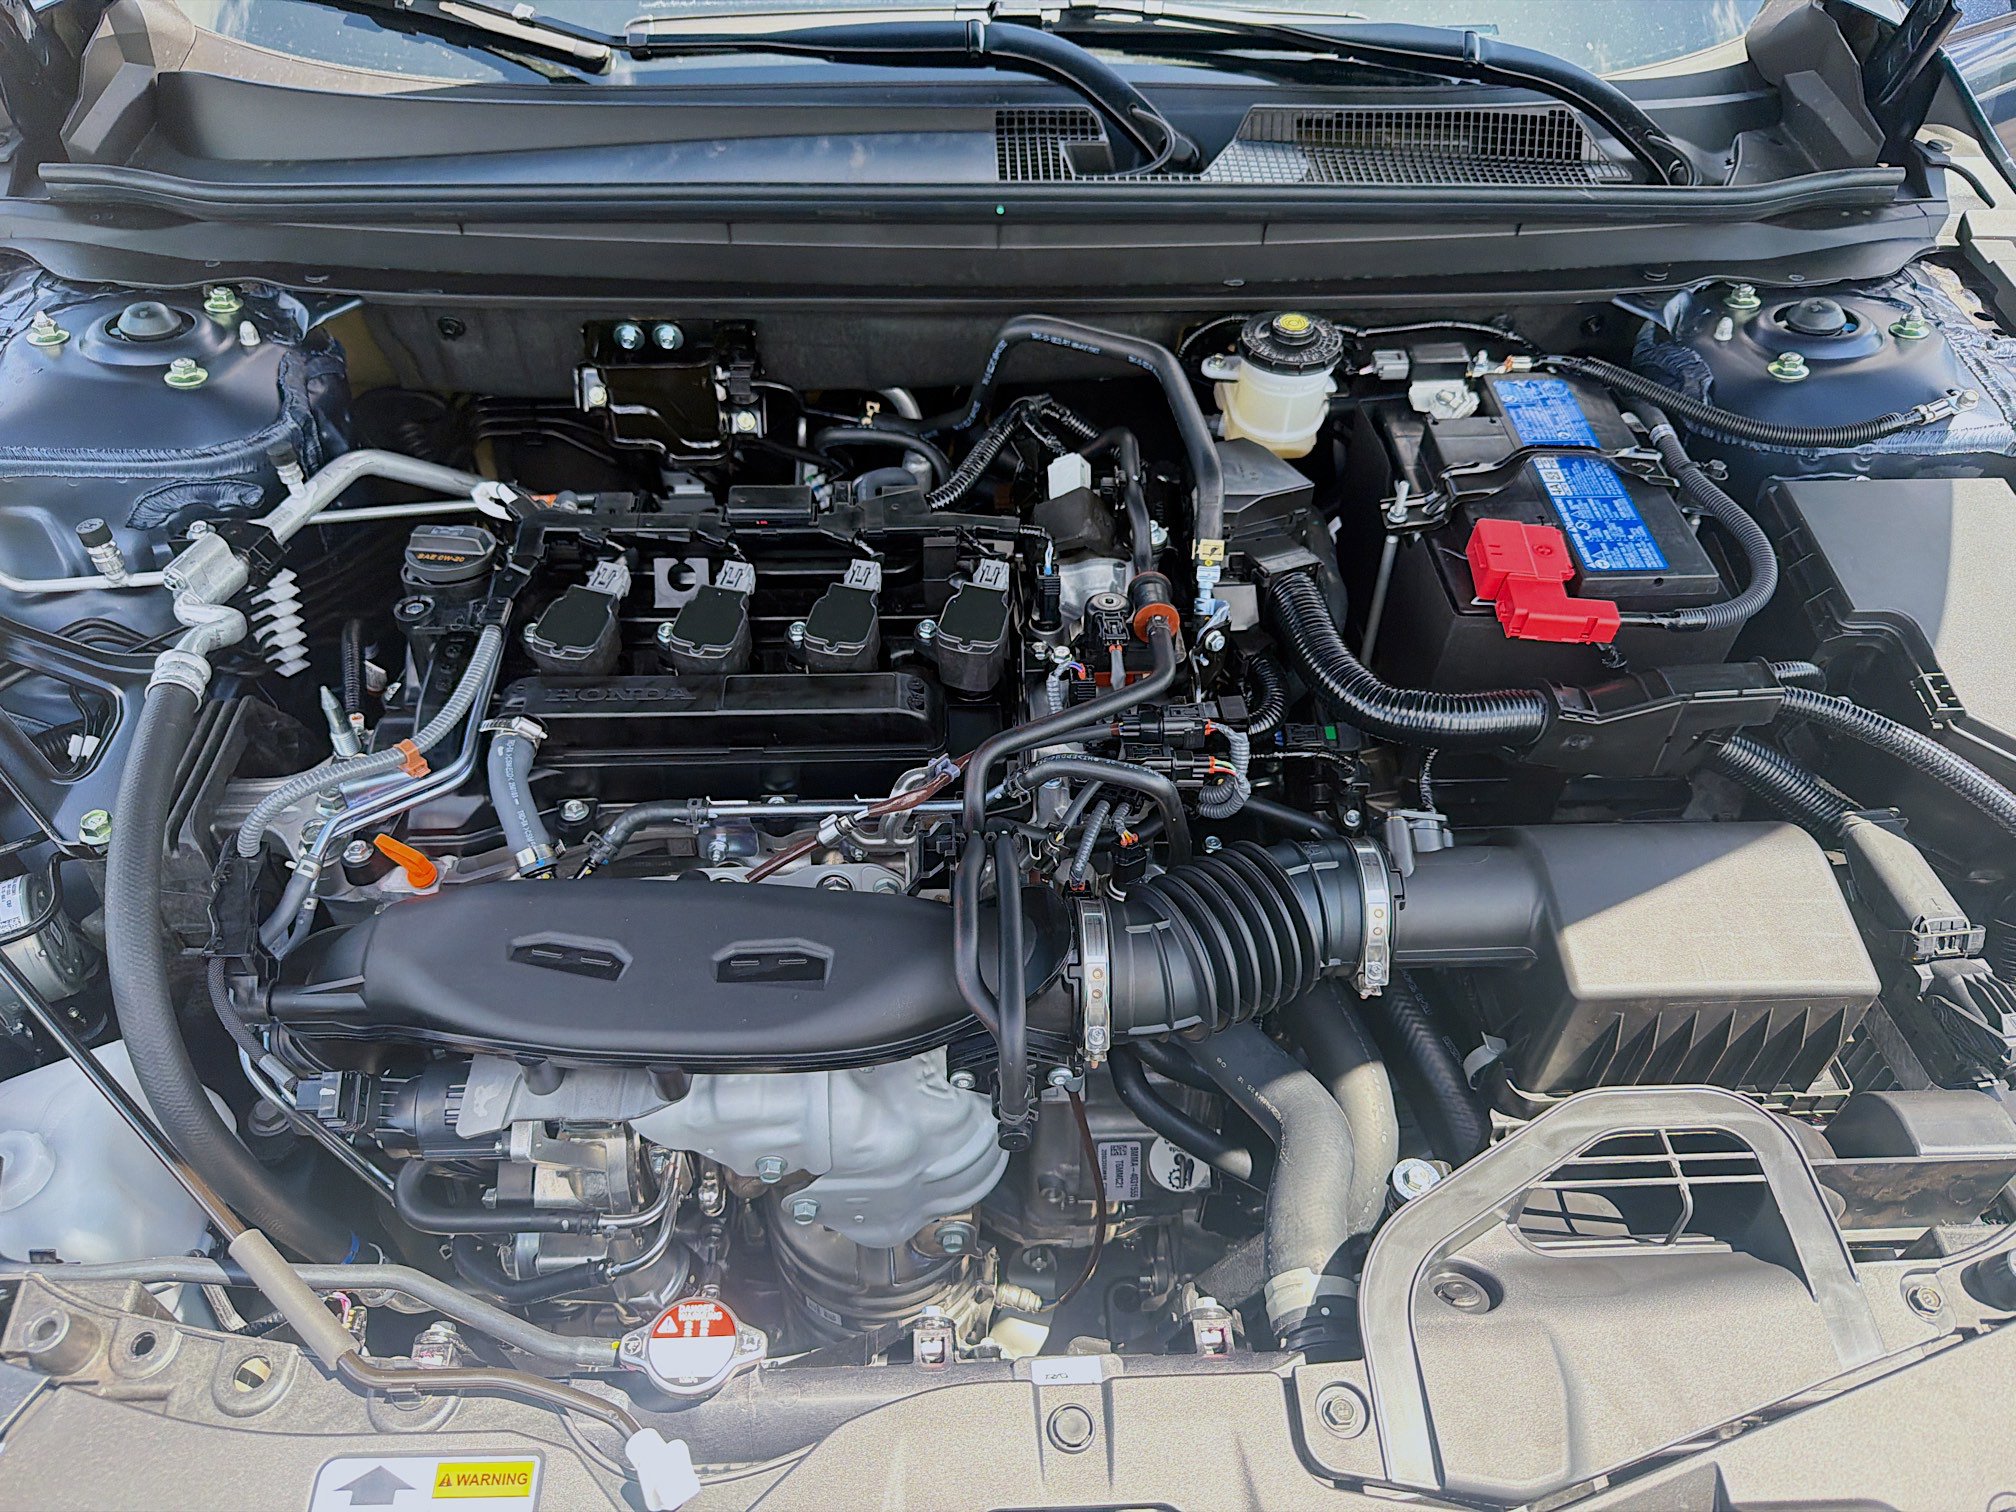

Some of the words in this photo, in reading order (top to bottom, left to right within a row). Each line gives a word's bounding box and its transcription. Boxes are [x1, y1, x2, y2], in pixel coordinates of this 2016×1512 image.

[416, 552, 437, 560] SAE
[438, 555, 466, 563] 0W-20
[545, 688, 697, 702] HONDA
[456, 1472, 528, 1486] WARNING
